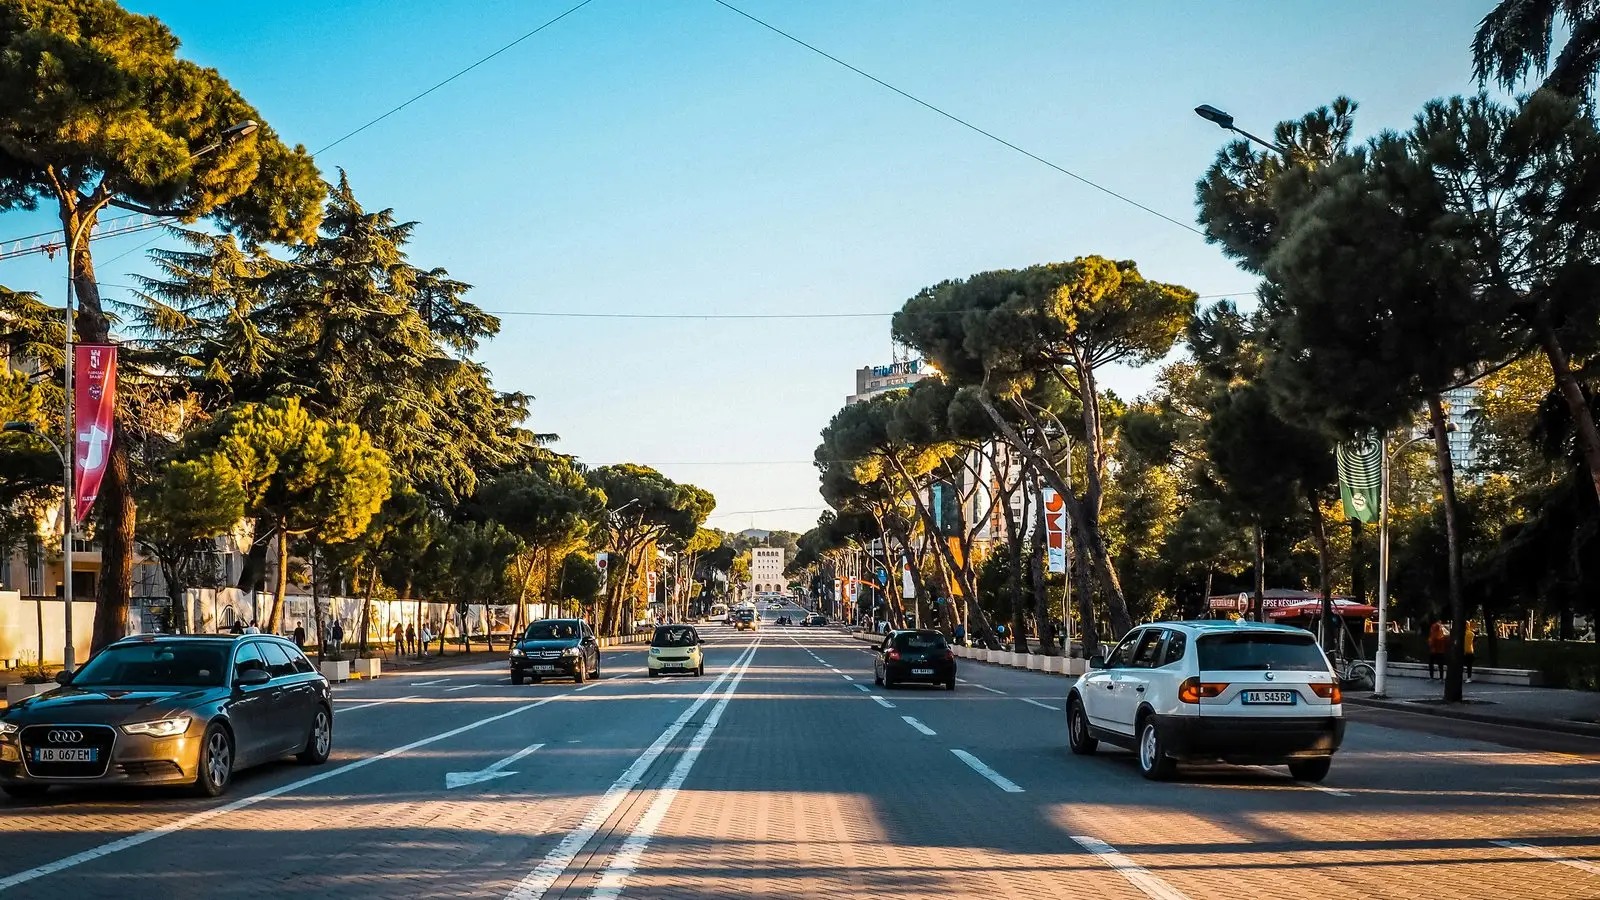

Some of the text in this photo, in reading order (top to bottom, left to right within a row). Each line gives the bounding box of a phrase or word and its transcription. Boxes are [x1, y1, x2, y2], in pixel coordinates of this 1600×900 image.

[1262, 599, 1278, 607] EPSE
[1249, 692, 1261, 702] AA
[42, 749, 54, 760] AB
